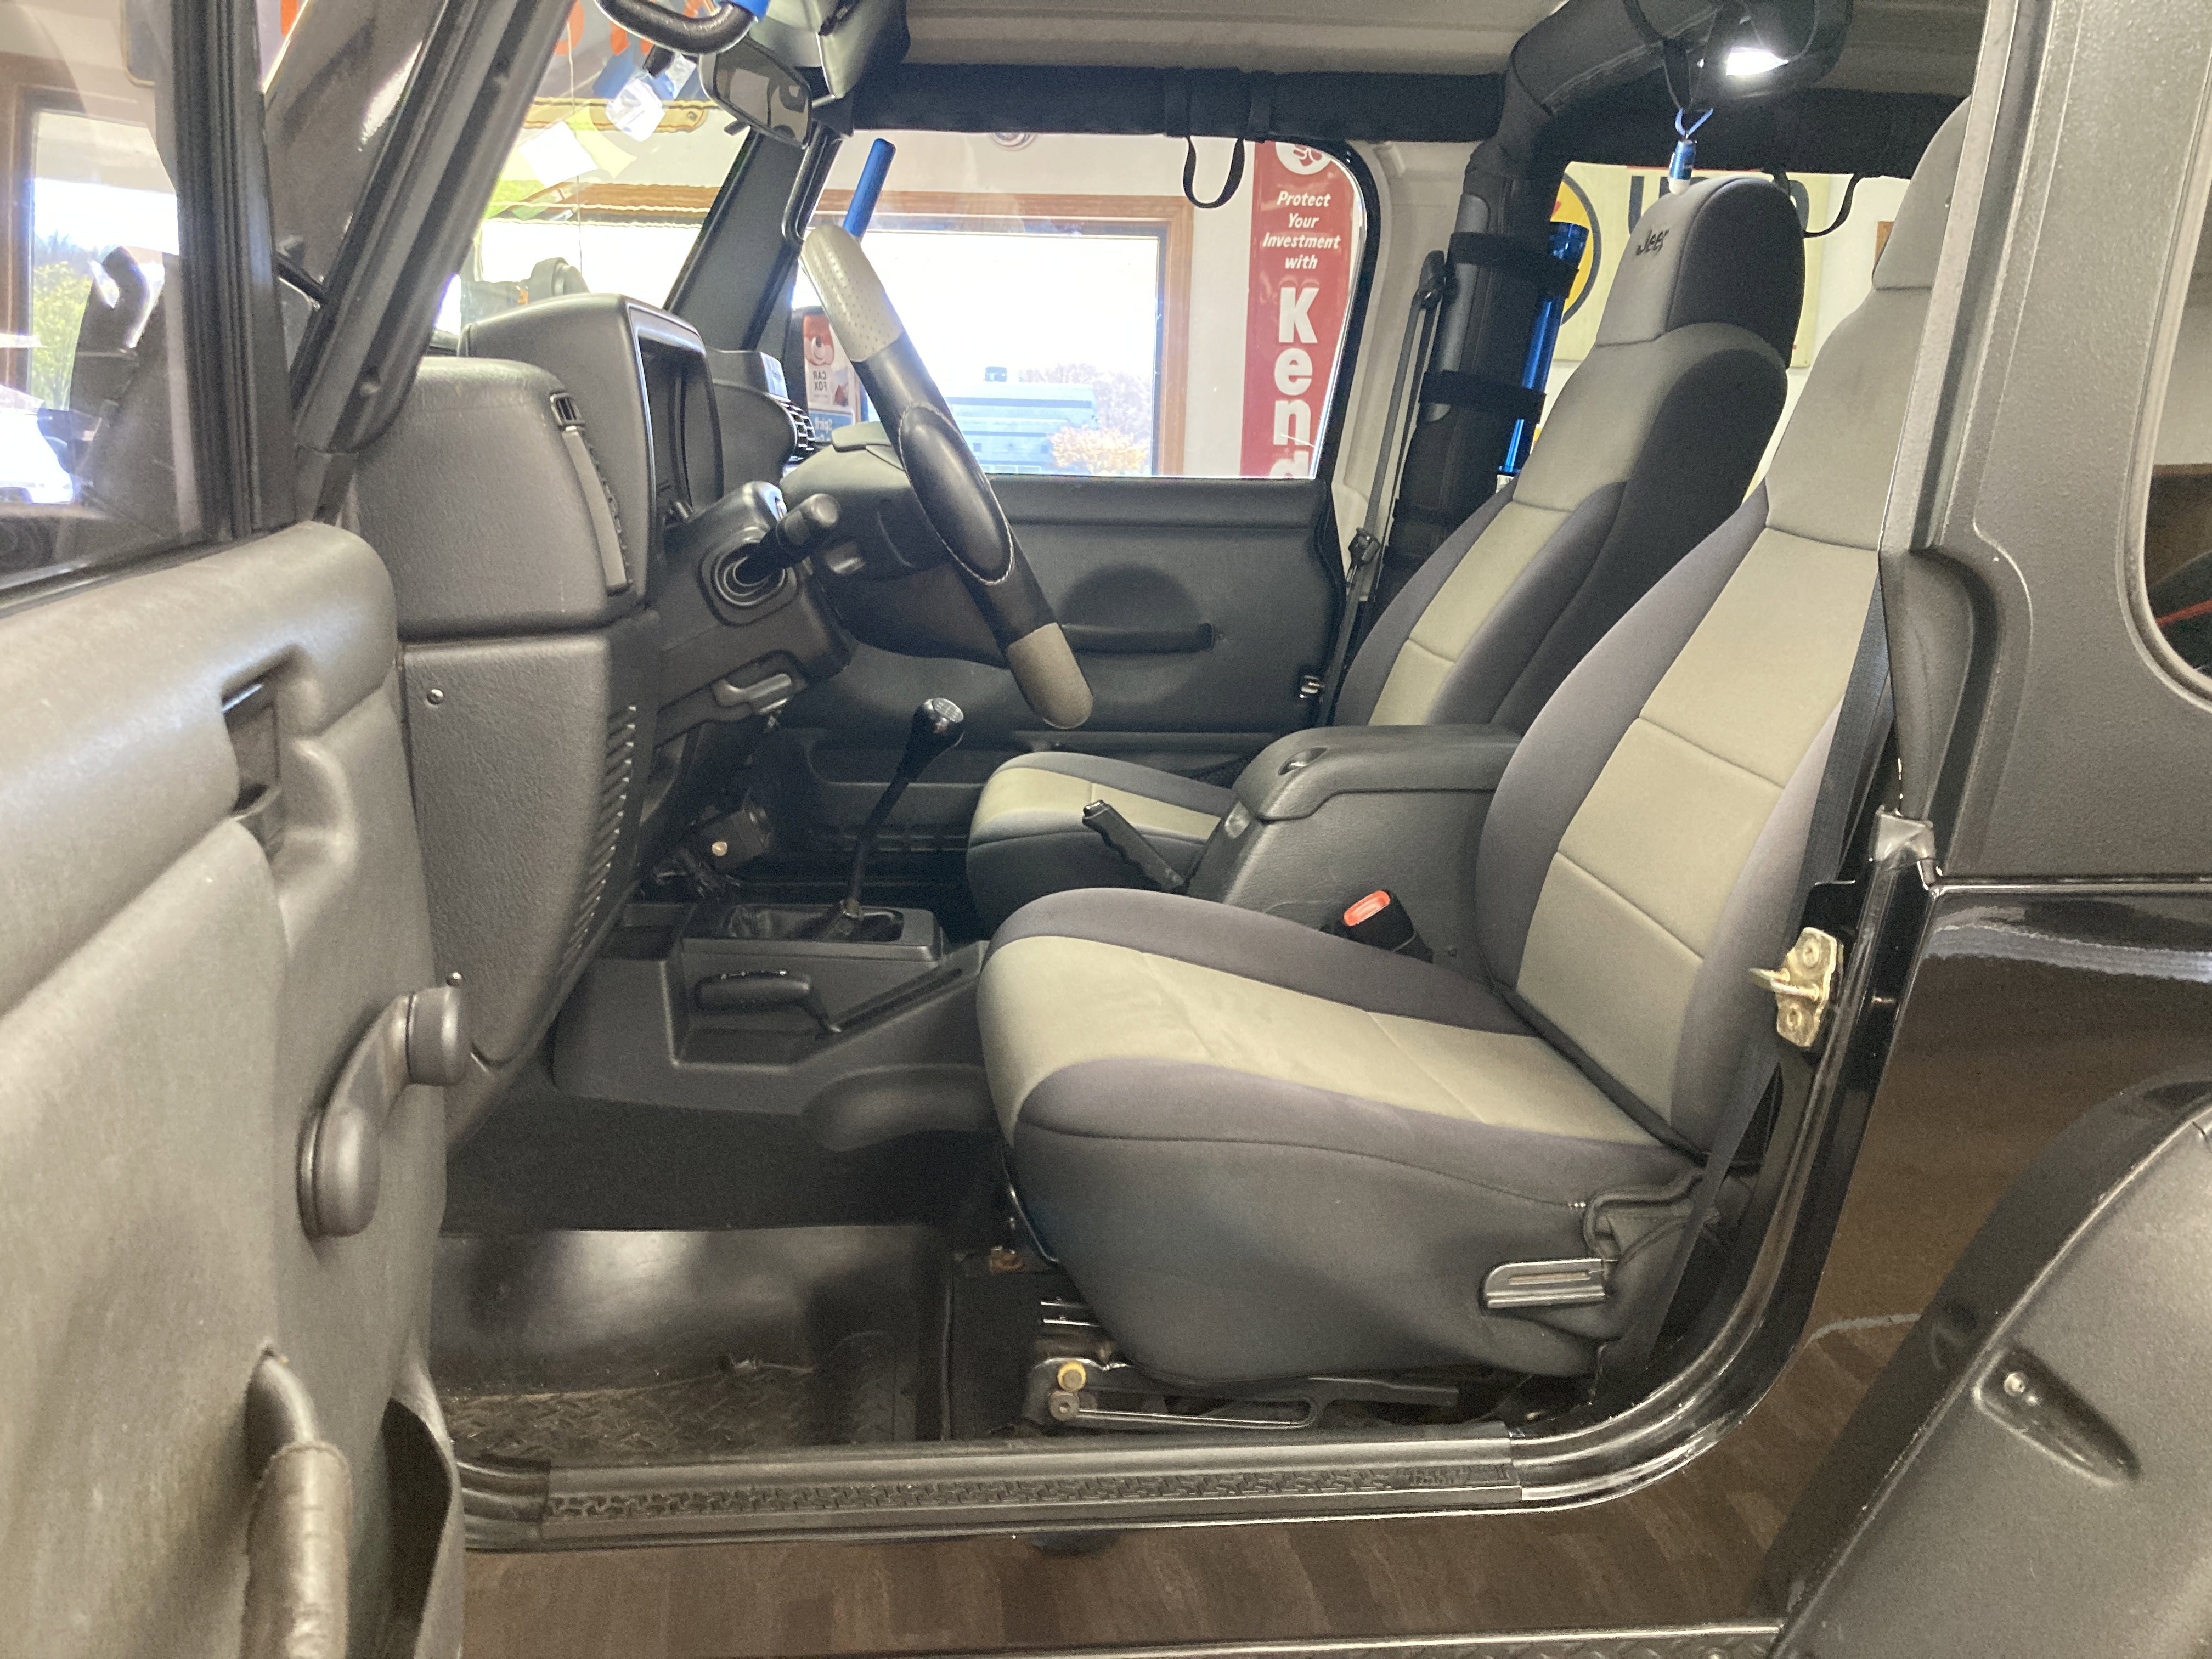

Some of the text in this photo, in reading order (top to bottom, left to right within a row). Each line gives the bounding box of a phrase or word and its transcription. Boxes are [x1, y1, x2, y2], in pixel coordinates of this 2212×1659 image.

[1277, 190, 1331, 207] Protect
[1288, 213, 1320, 228] Your
[1262, 232, 1341, 249] Investment
[1285, 254, 1318, 269] with
